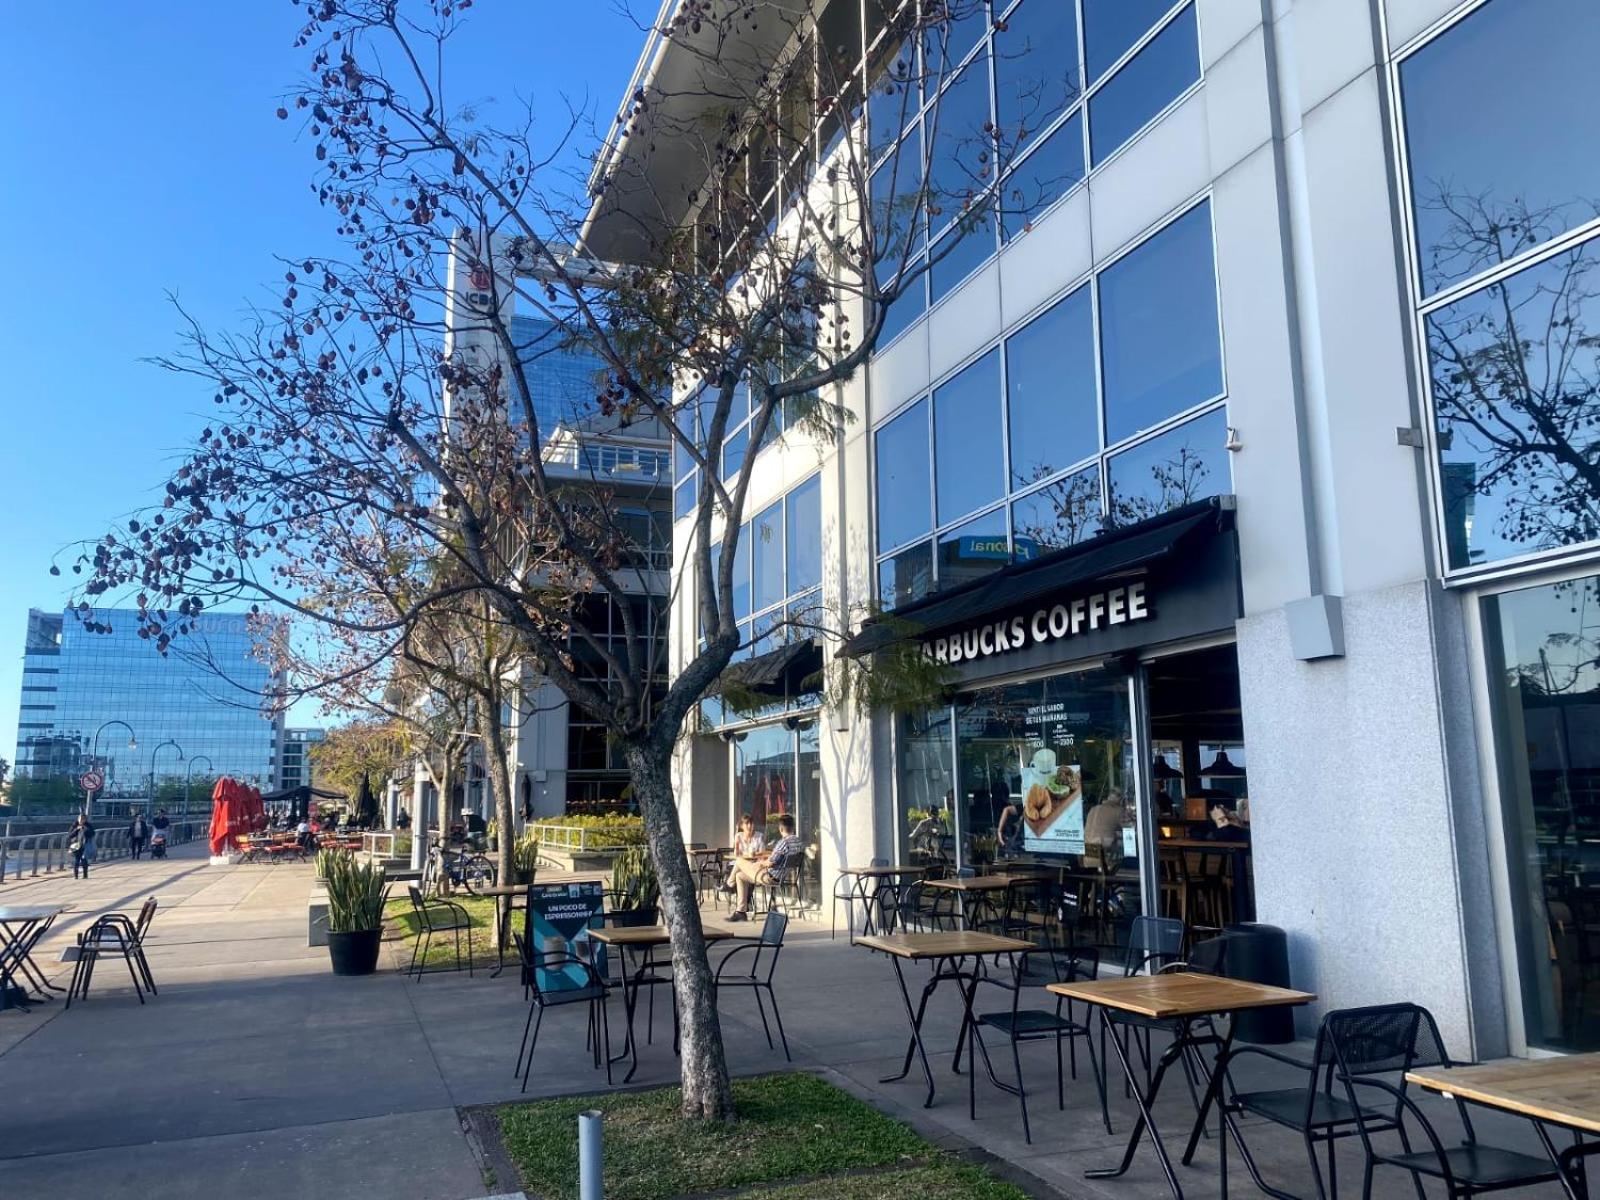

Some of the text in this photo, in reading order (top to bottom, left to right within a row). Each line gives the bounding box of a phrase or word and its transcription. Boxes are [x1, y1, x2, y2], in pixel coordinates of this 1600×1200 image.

[466, 292, 498, 306] ICB
[909, 581, 1149, 668] ARBUCKS COFFEE
[559, 903, 578, 911] POCO
